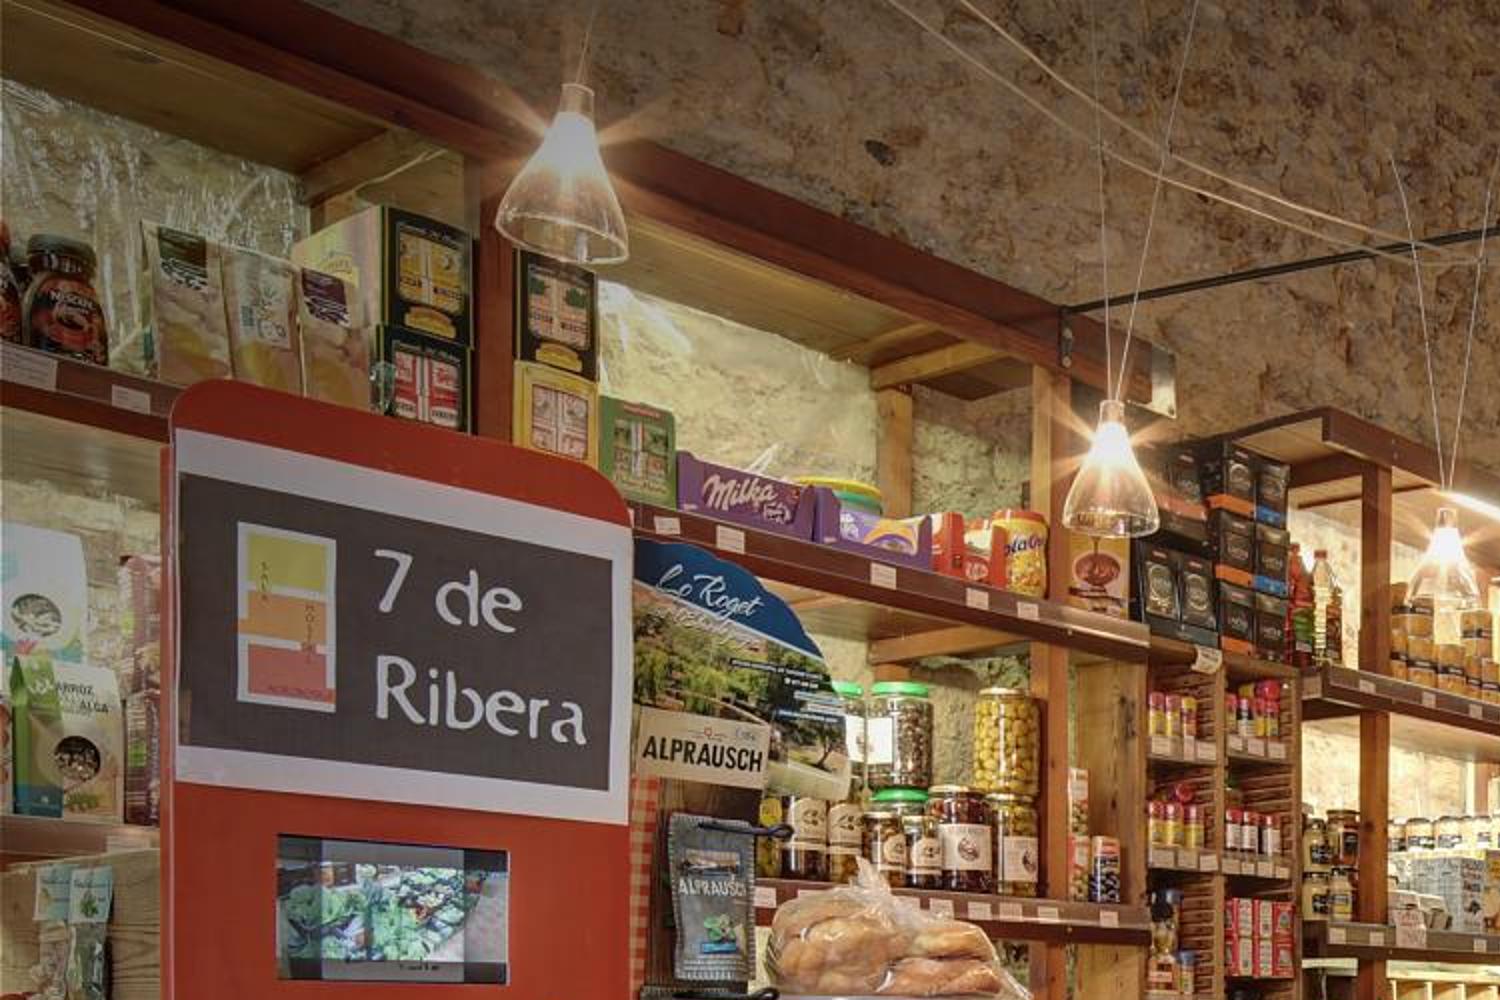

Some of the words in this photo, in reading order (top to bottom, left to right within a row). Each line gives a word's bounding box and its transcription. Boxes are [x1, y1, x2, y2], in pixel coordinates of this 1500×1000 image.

[702, 474, 778, 511] Milka
[373, 549, 414, 613] 7
[435, 569, 523, 633] de
[693, 573, 765, 621] Roget
[376, 654, 588, 746] Ribera
[642, 735, 763, 772] ALPRAUSCH
